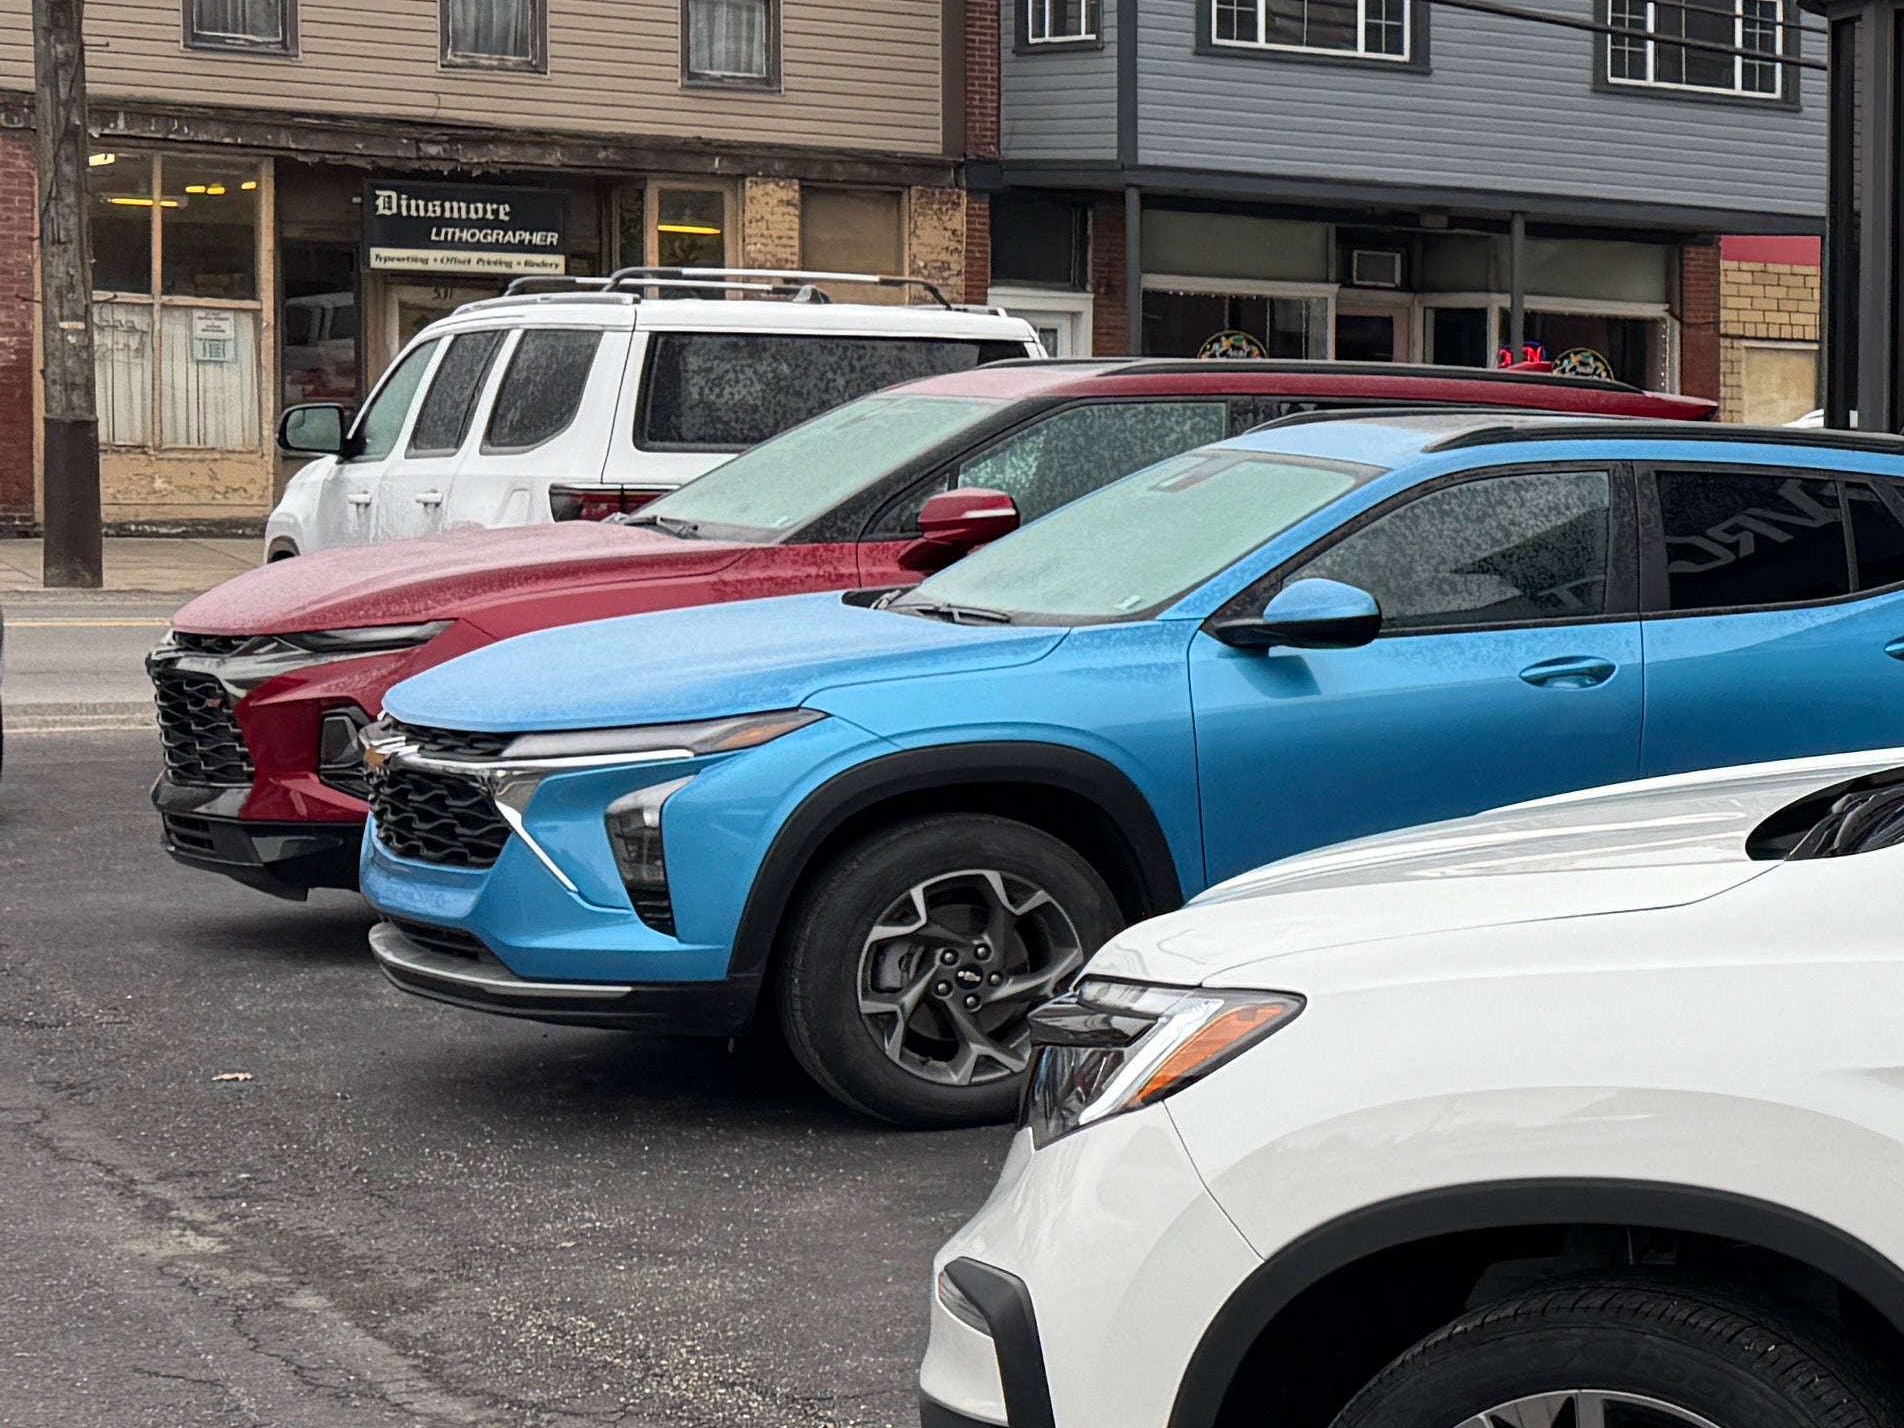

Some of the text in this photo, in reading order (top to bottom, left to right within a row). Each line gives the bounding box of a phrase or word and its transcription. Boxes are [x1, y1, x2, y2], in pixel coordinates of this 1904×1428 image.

[375, 189, 512, 222] Dinsmore
[430, 227, 559, 247] LITHOGRAPHER
[476, 257, 513, 269] Printing
[524, 259, 560, 270] Bindery
